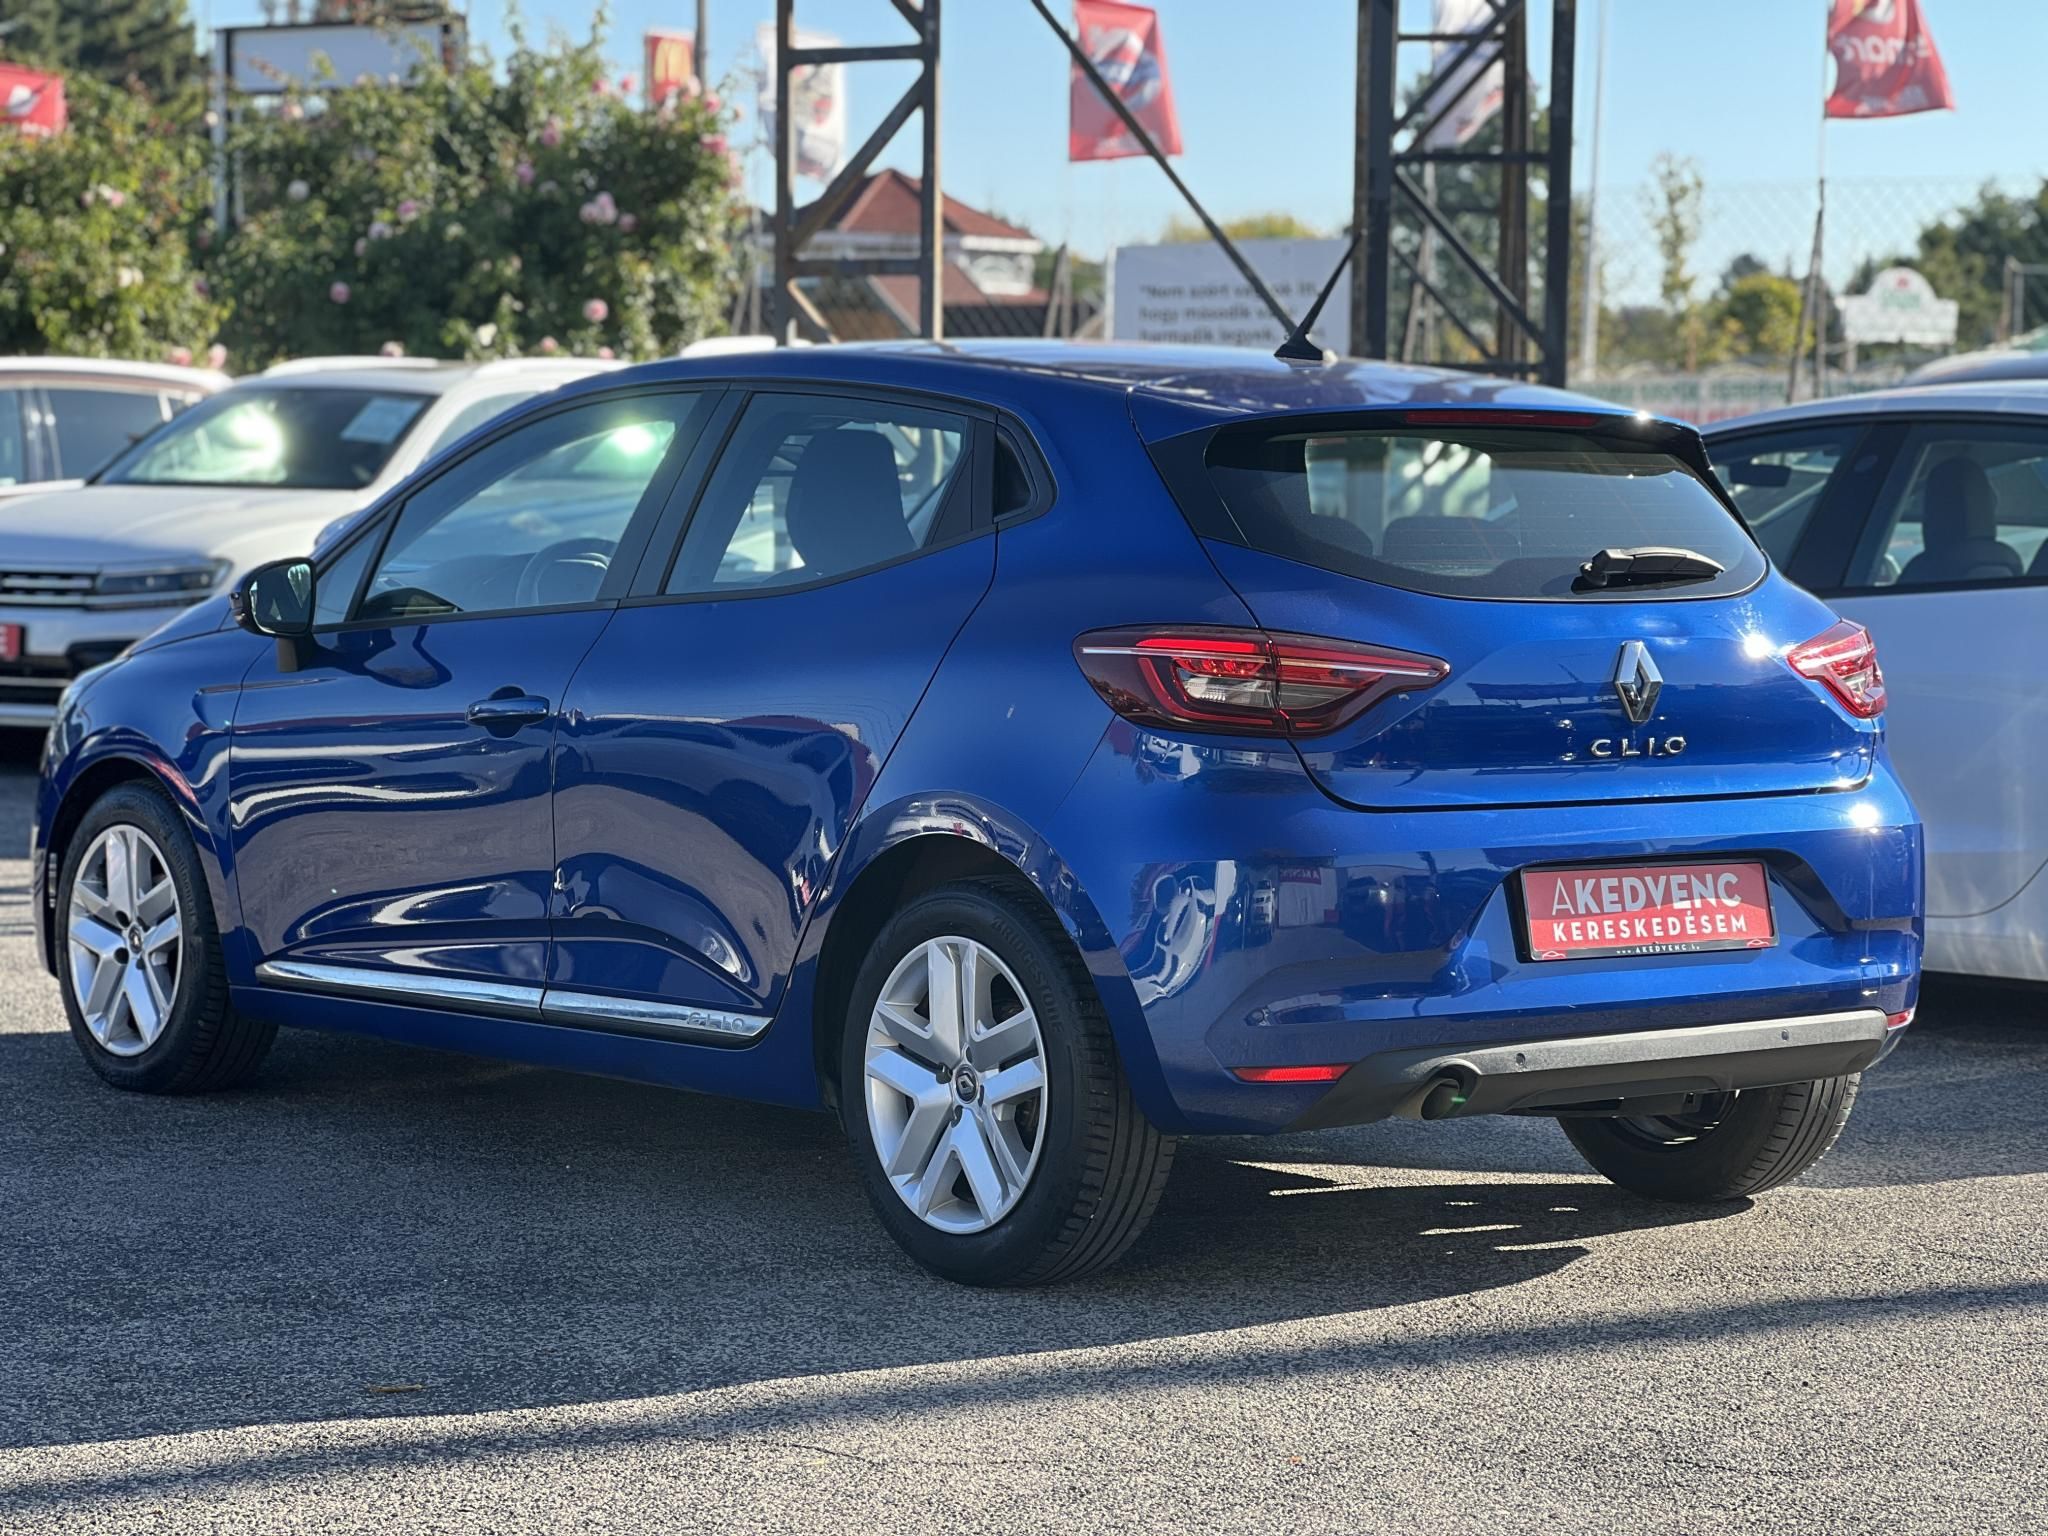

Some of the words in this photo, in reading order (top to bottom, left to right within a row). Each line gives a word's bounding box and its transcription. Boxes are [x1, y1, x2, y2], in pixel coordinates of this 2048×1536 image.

[1590, 736, 1686, 757] CLIO
[1552, 872, 1742, 915] AKEDVENC
[1553, 910, 1747, 942] KERESKEDÉSEM
[686, 1011, 745, 1032] CLIO
